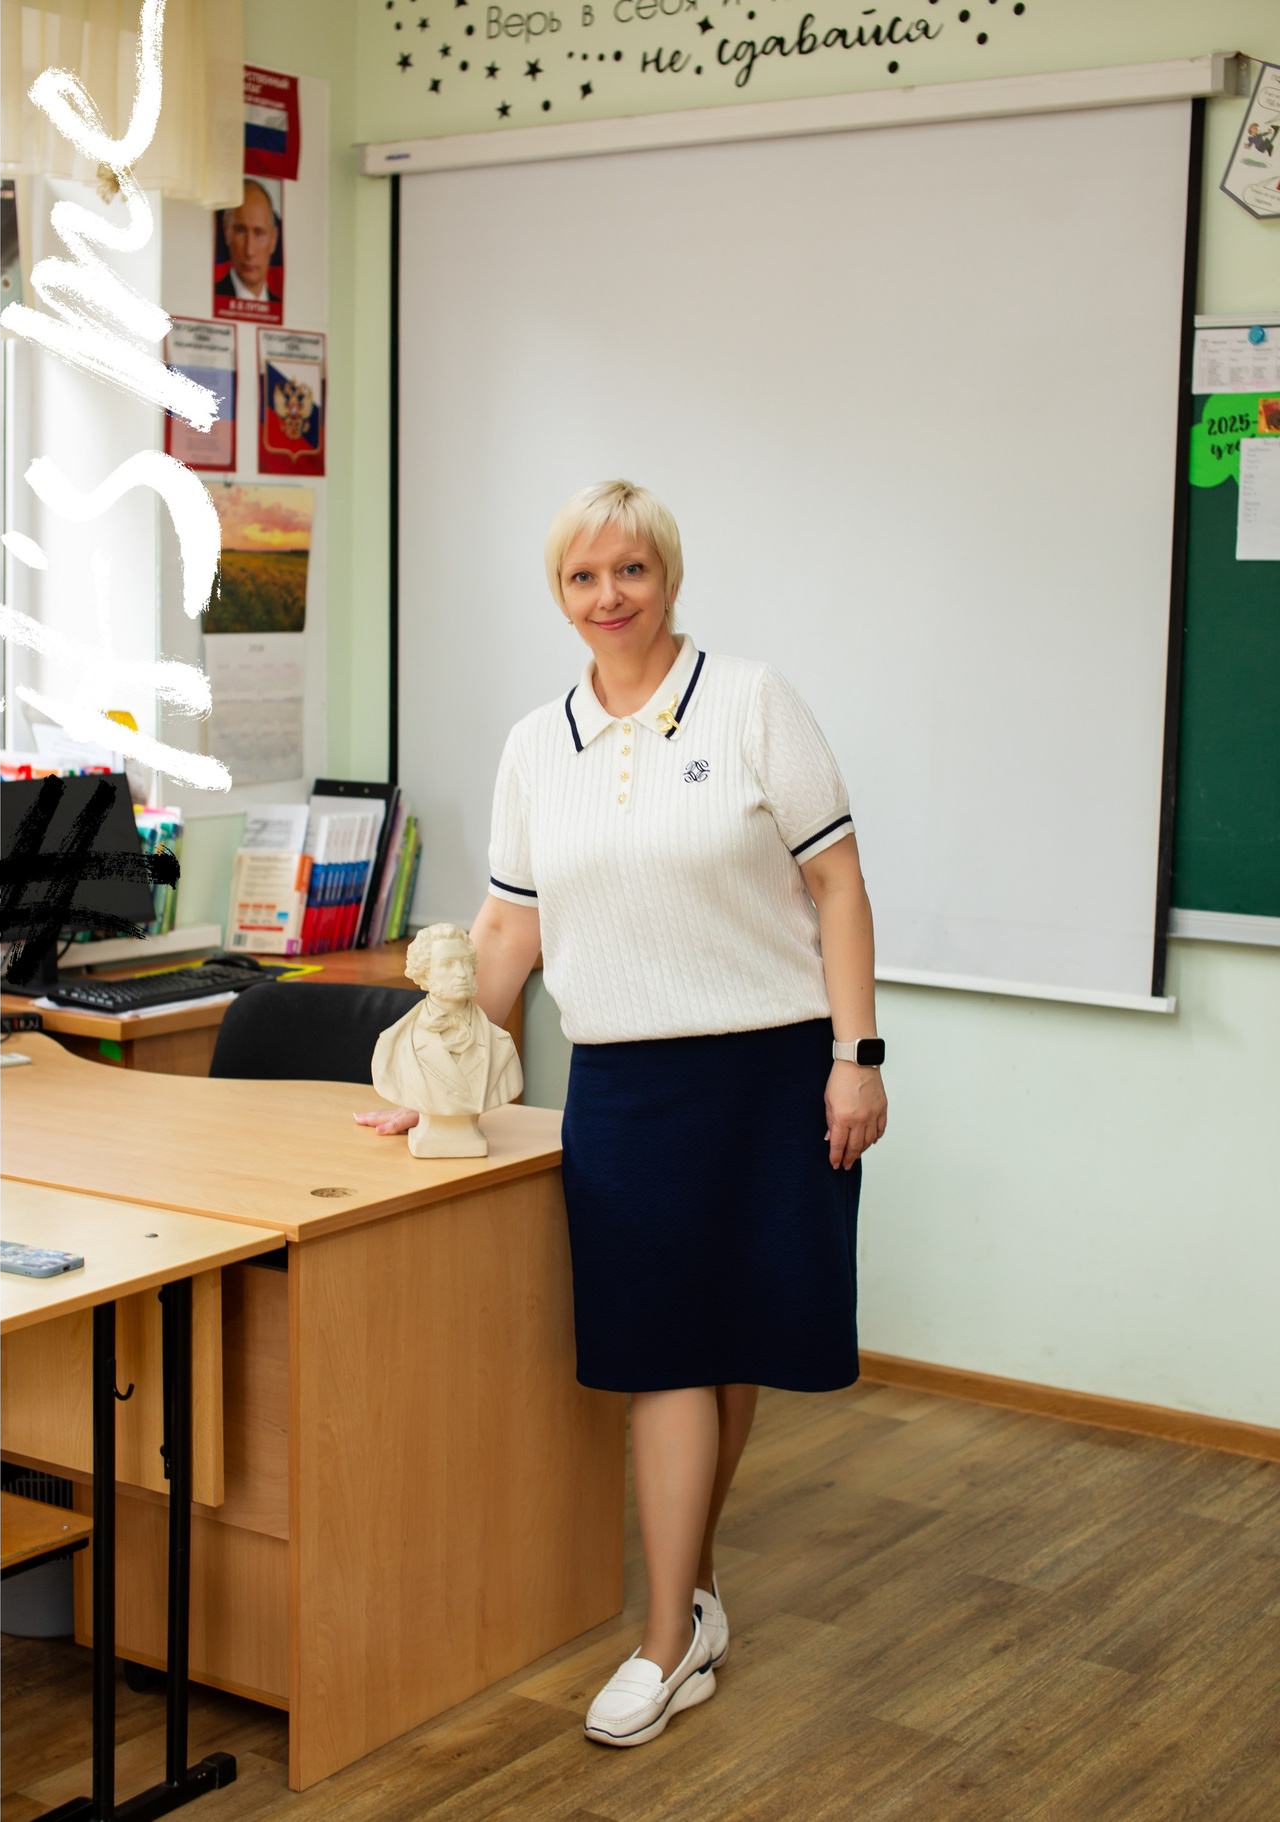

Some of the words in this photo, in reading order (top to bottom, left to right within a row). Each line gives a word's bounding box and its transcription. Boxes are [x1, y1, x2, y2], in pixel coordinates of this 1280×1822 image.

[486, 5, 562, 44] Верь
[581, 4, 595, 27] в
[641, 46, 692, 74] не
[717, 9, 945, 88] сдавайся
[1207, 413, 1258, 437] 2025-
